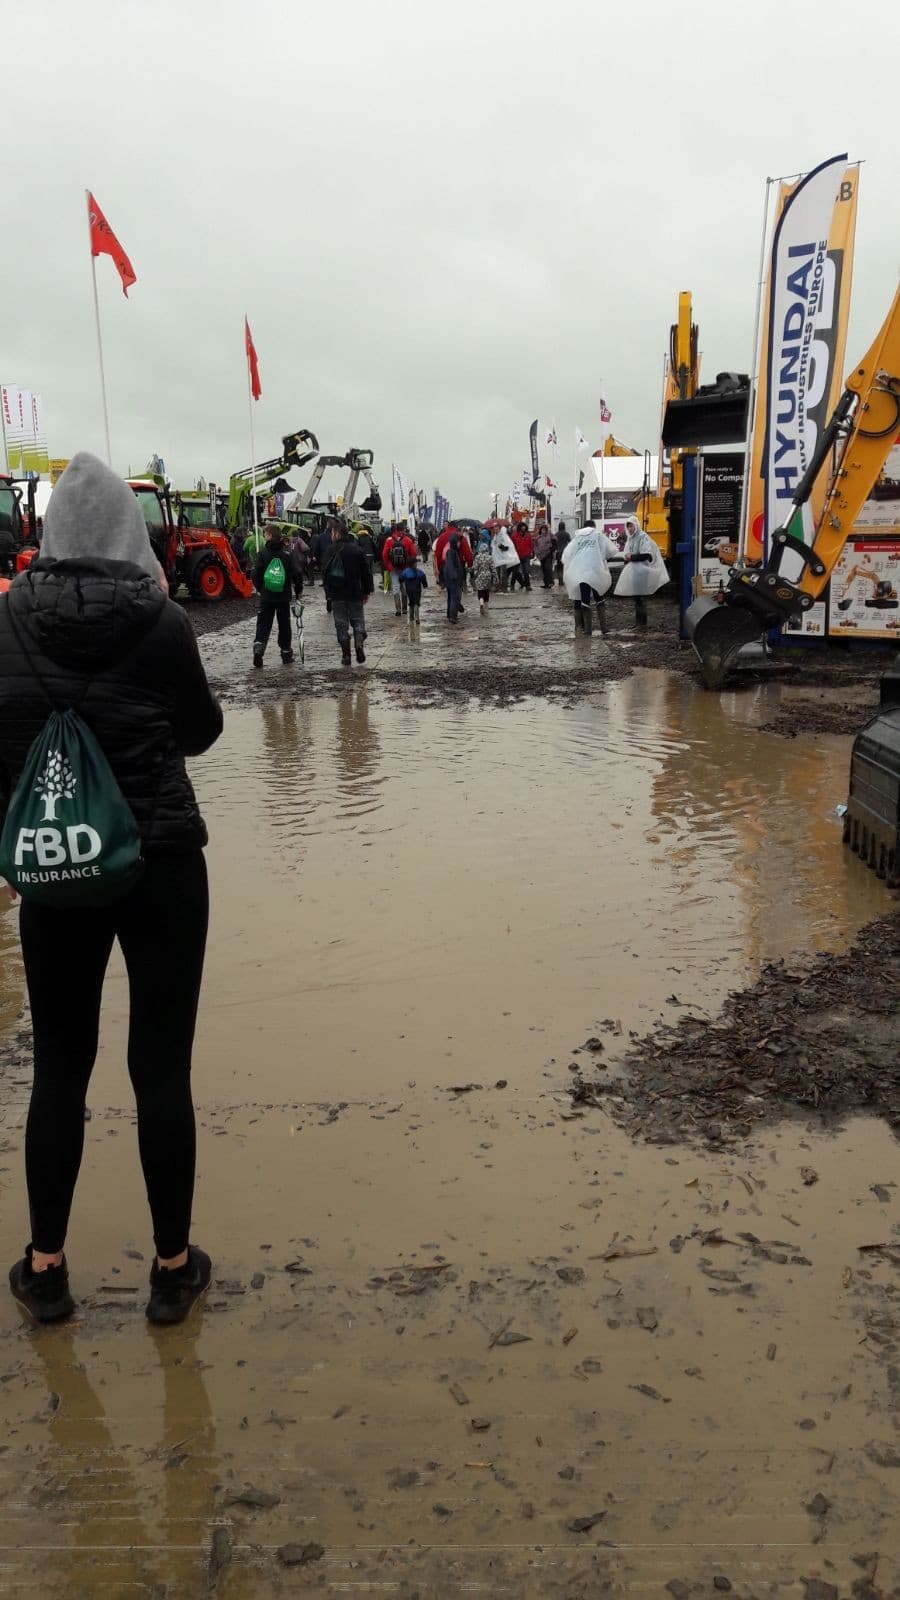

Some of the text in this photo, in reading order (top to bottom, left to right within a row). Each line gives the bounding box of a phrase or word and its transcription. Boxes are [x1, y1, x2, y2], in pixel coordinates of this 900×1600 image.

[797, 321, 814, 434] INDUSTRIES
[807, 239, 828, 317] EUROPE
[774, 242, 817, 500] HYUNDAI
[704, 473, 745, 484] No Compa
[14, 823, 103, 867] FBD
[16, 865, 102, 884] INSURANCE
